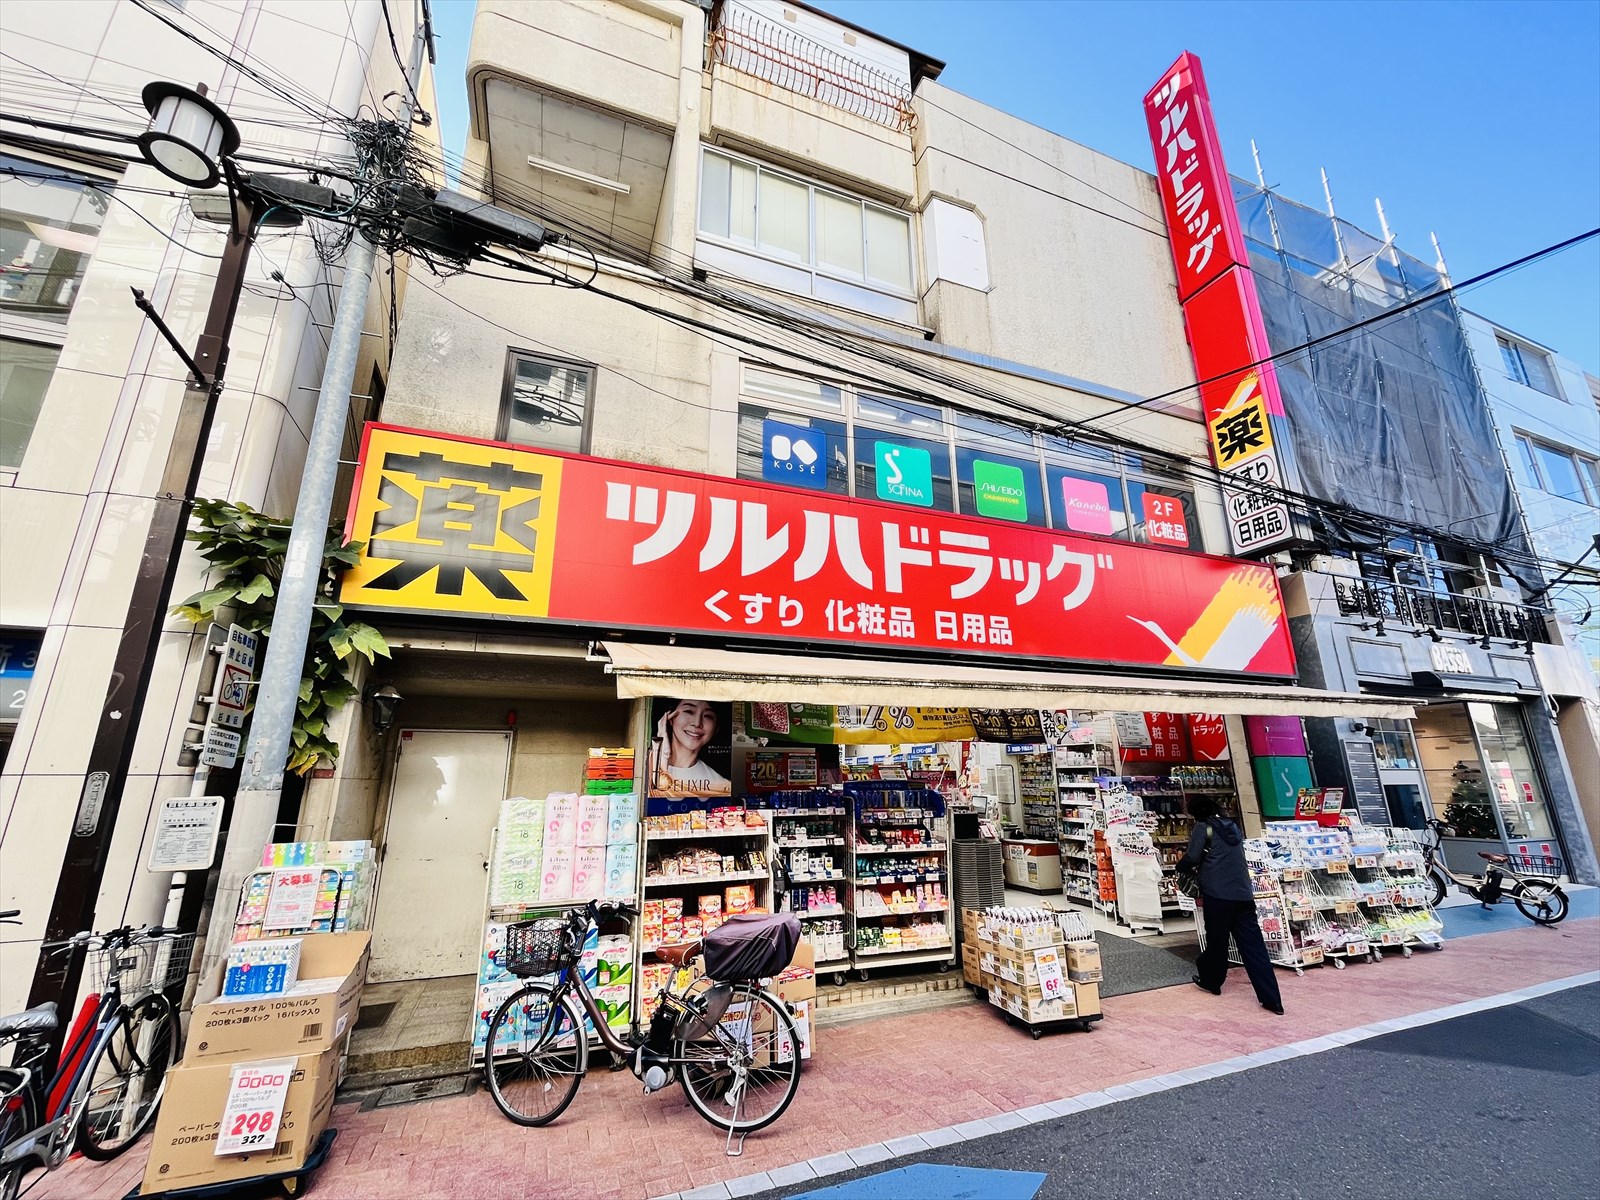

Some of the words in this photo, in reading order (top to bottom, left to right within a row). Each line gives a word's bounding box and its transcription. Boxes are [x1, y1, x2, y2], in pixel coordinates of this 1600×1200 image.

[1153, 71, 1222, 274] ツルハドラッグ
[1215, 404, 1265, 463] 薬
[774, 460, 816, 475] KOSÉ
[888, 483, 924, 499] SOFINA
[978, 482, 1023, 497] SHISEIDO
[1068, 497, 1107, 513] Kanebo
[1153, 500, 1174, 516] 2F
[362, 451, 544, 601] 薬
[1149, 518, 1187, 542] 化粧品
[1238, 510, 1284, 544] 日用品
[605, 481, 1114, 611] ツルハドラッグ
[704, 589, 804, 627] くすり
[825, 599, 915, 639] 化粧品
[935, 611, 1013, 646] 日用品
[1041, 709, 1057, 738] 免税
[758, 762, 775, 780] 20
[673, 778, 711, 792] ELIXIR
[1266, 932, 1283, 940] 105
[211, 1004, 266, 1016] ペーパータオル
[270, 998, 318, 1010] 100%パルプ
[276, 1008, 320, 1020] 16パック入り
[231, 1111, 275, 1136] 298
[241, 1134, 265, 1145] 327
